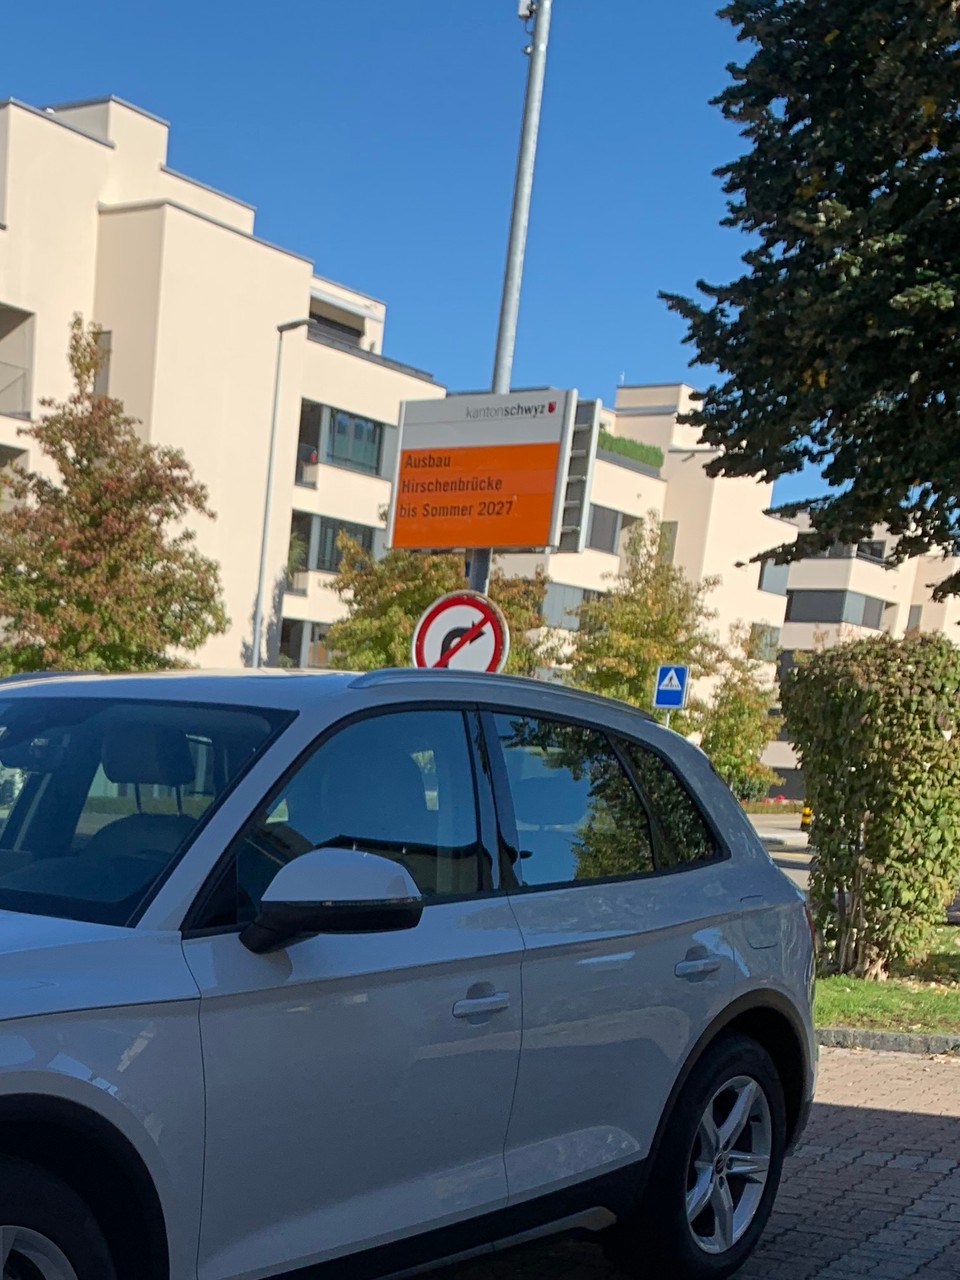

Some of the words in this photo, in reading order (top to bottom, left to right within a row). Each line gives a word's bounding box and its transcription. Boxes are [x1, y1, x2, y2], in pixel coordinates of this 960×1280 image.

[404, 453, 451, 469] Ausbau
[402, 477, 503, 493] Hirschenbrücke
[399, 504, 417, 518] bis
[422, 502, 474, 517] Sommer
[477, 500, 514, 516] 2027
